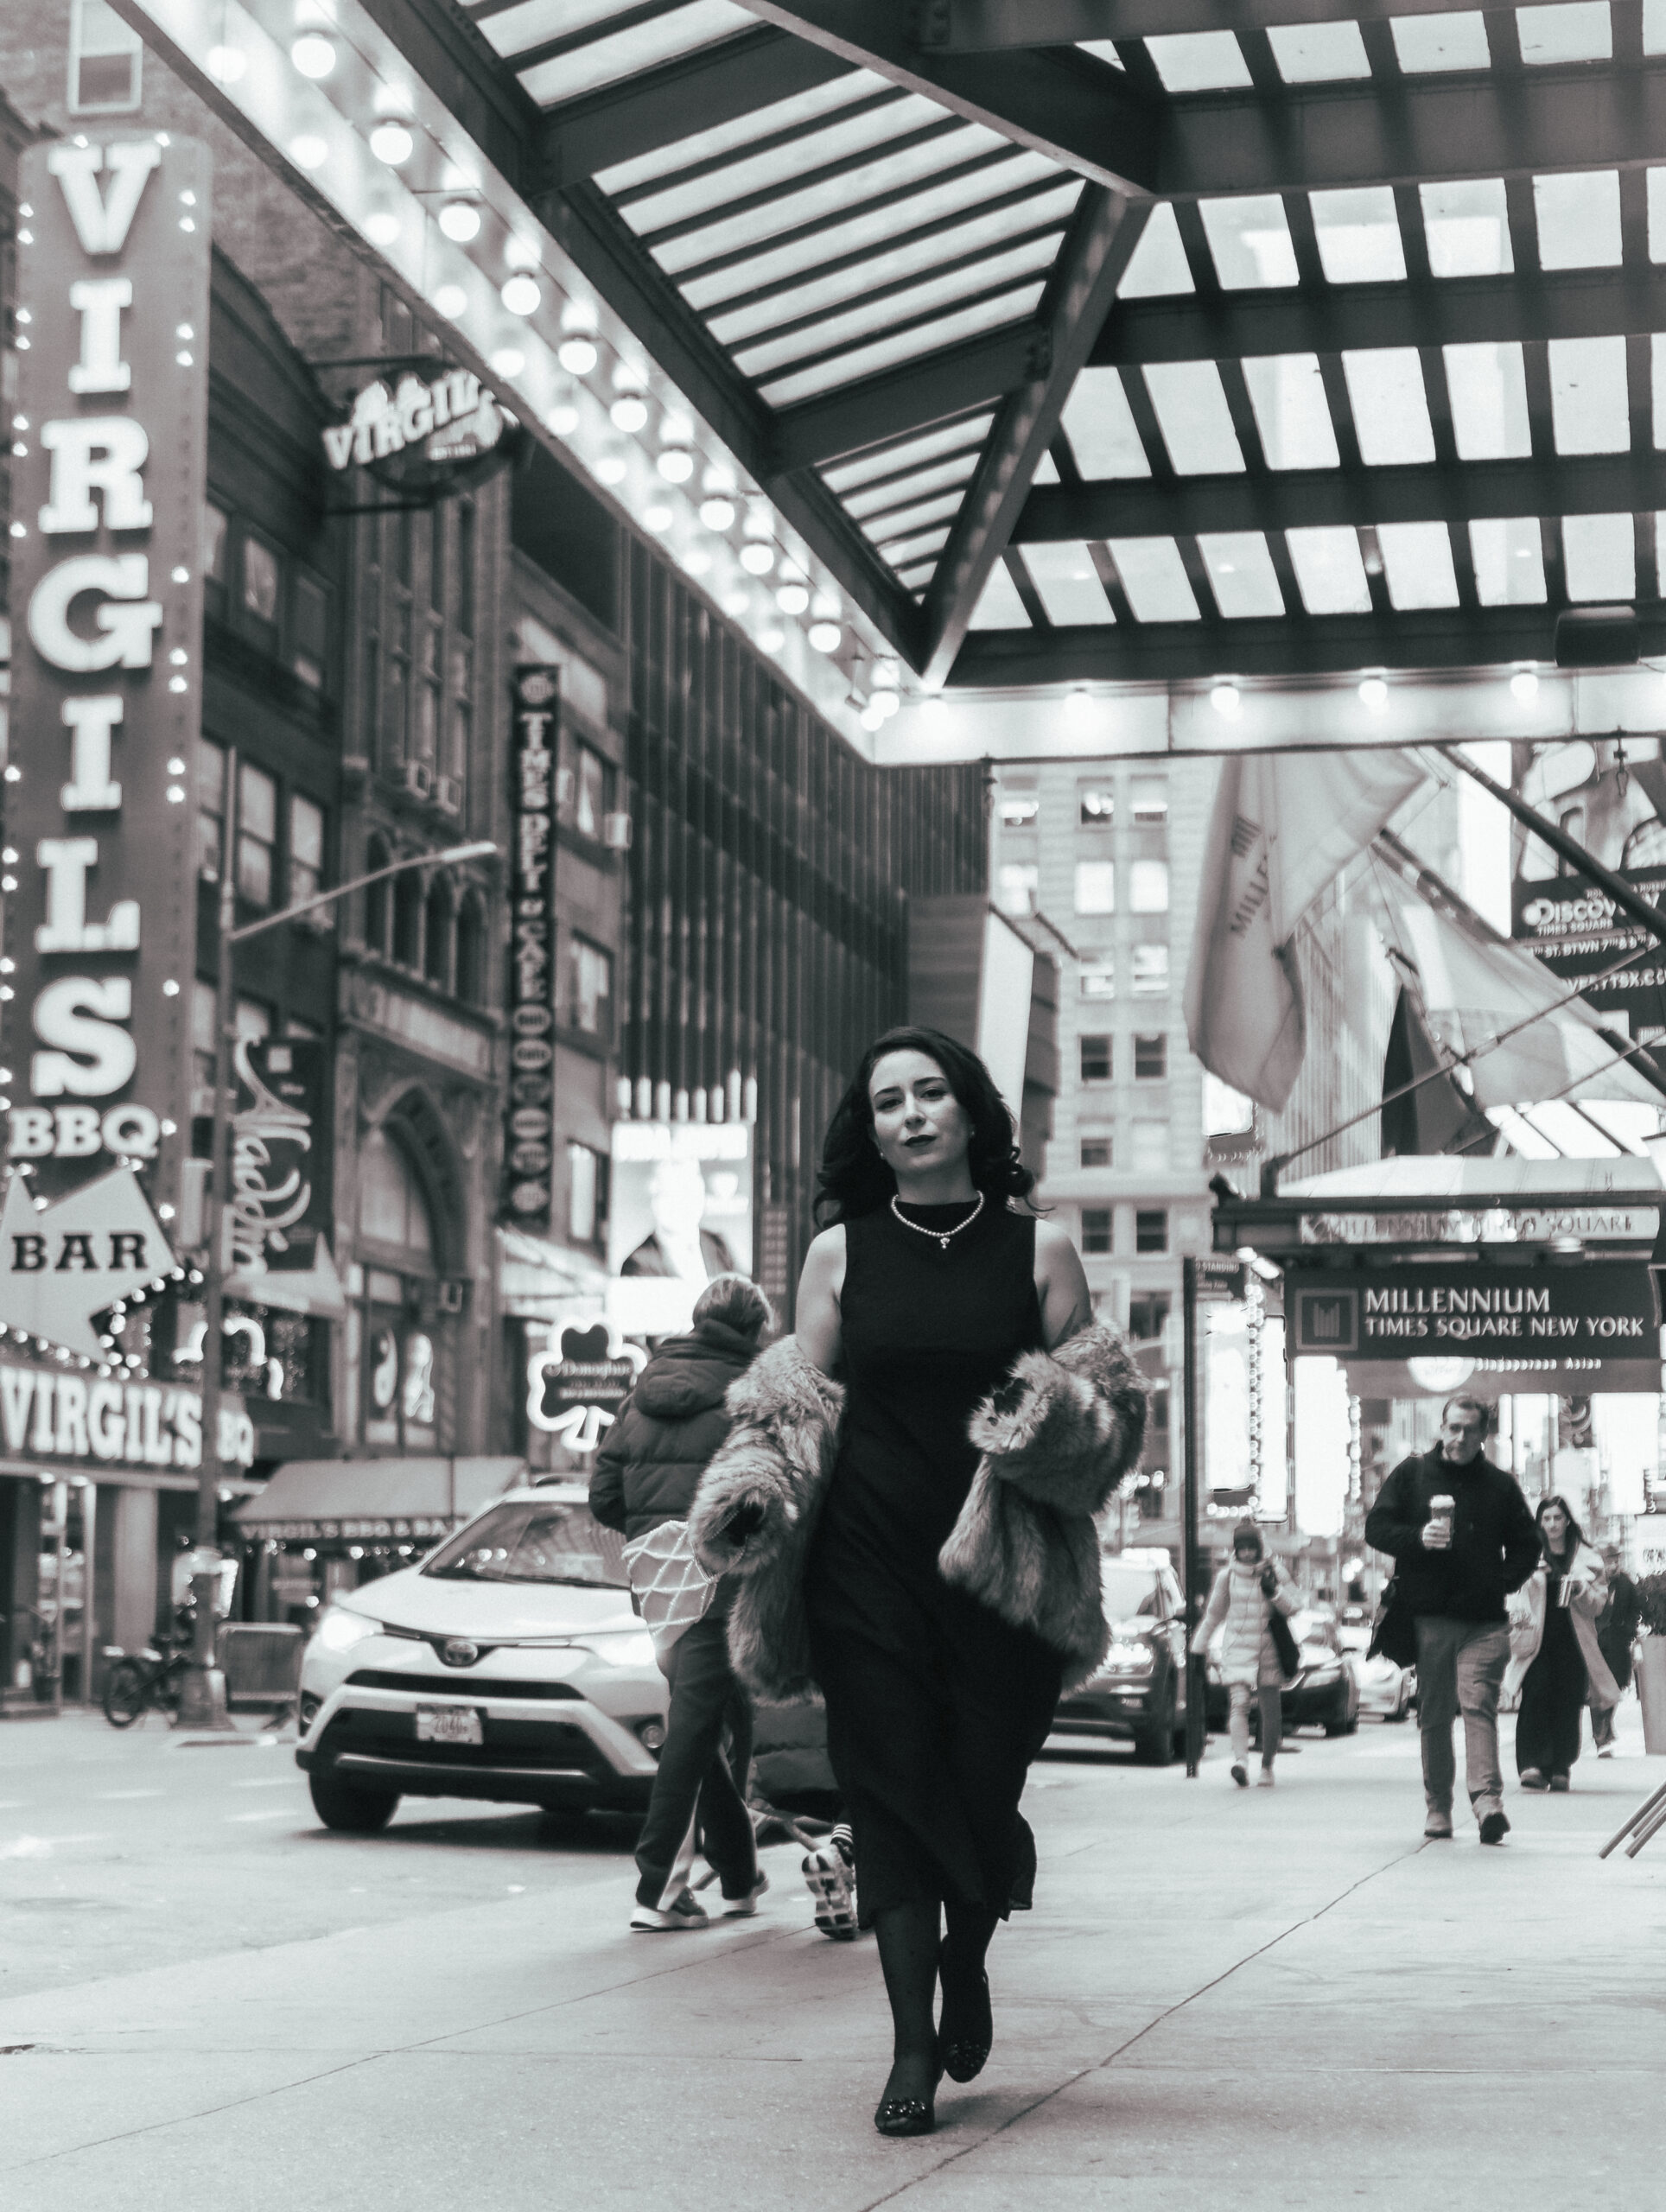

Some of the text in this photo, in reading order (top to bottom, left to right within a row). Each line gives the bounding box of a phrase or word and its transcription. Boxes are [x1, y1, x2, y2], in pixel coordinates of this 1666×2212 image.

[322, 369, 482, 469] VIRGIL
[7, 1103, 159, 1159] BBQ
[11, 1234, 148, 1271] BAR
[1364, 1287, 1551, 1313] MILLENNIUM
[1364, 1316, 1645, 1340] TIMES SQUARE NEW YORK
[0, 1364, 203, 1468] VIRGIL'S
